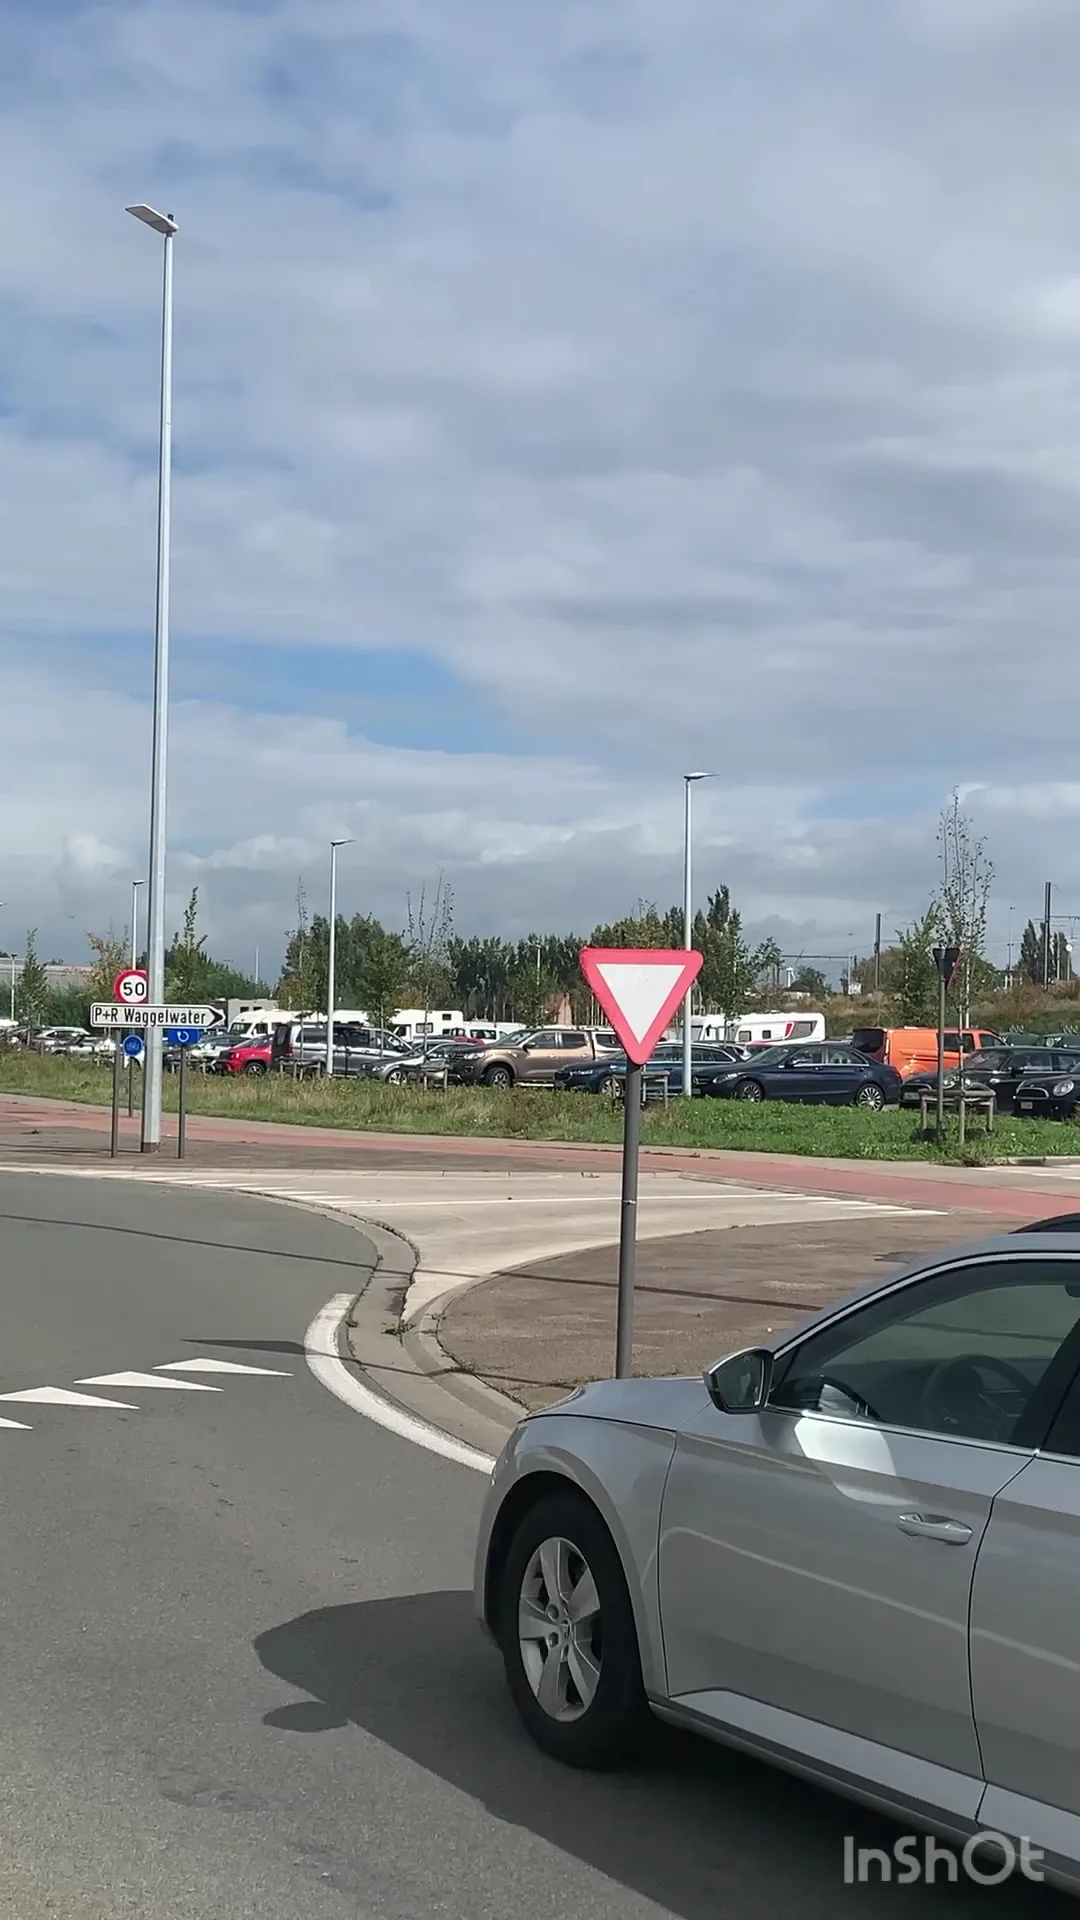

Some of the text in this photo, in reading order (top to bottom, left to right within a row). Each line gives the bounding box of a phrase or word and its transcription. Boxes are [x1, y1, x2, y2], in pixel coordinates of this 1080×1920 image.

[123, 982, 145, 996] 50
[94, 1008, 206, 1027] P+R Waggelwater
